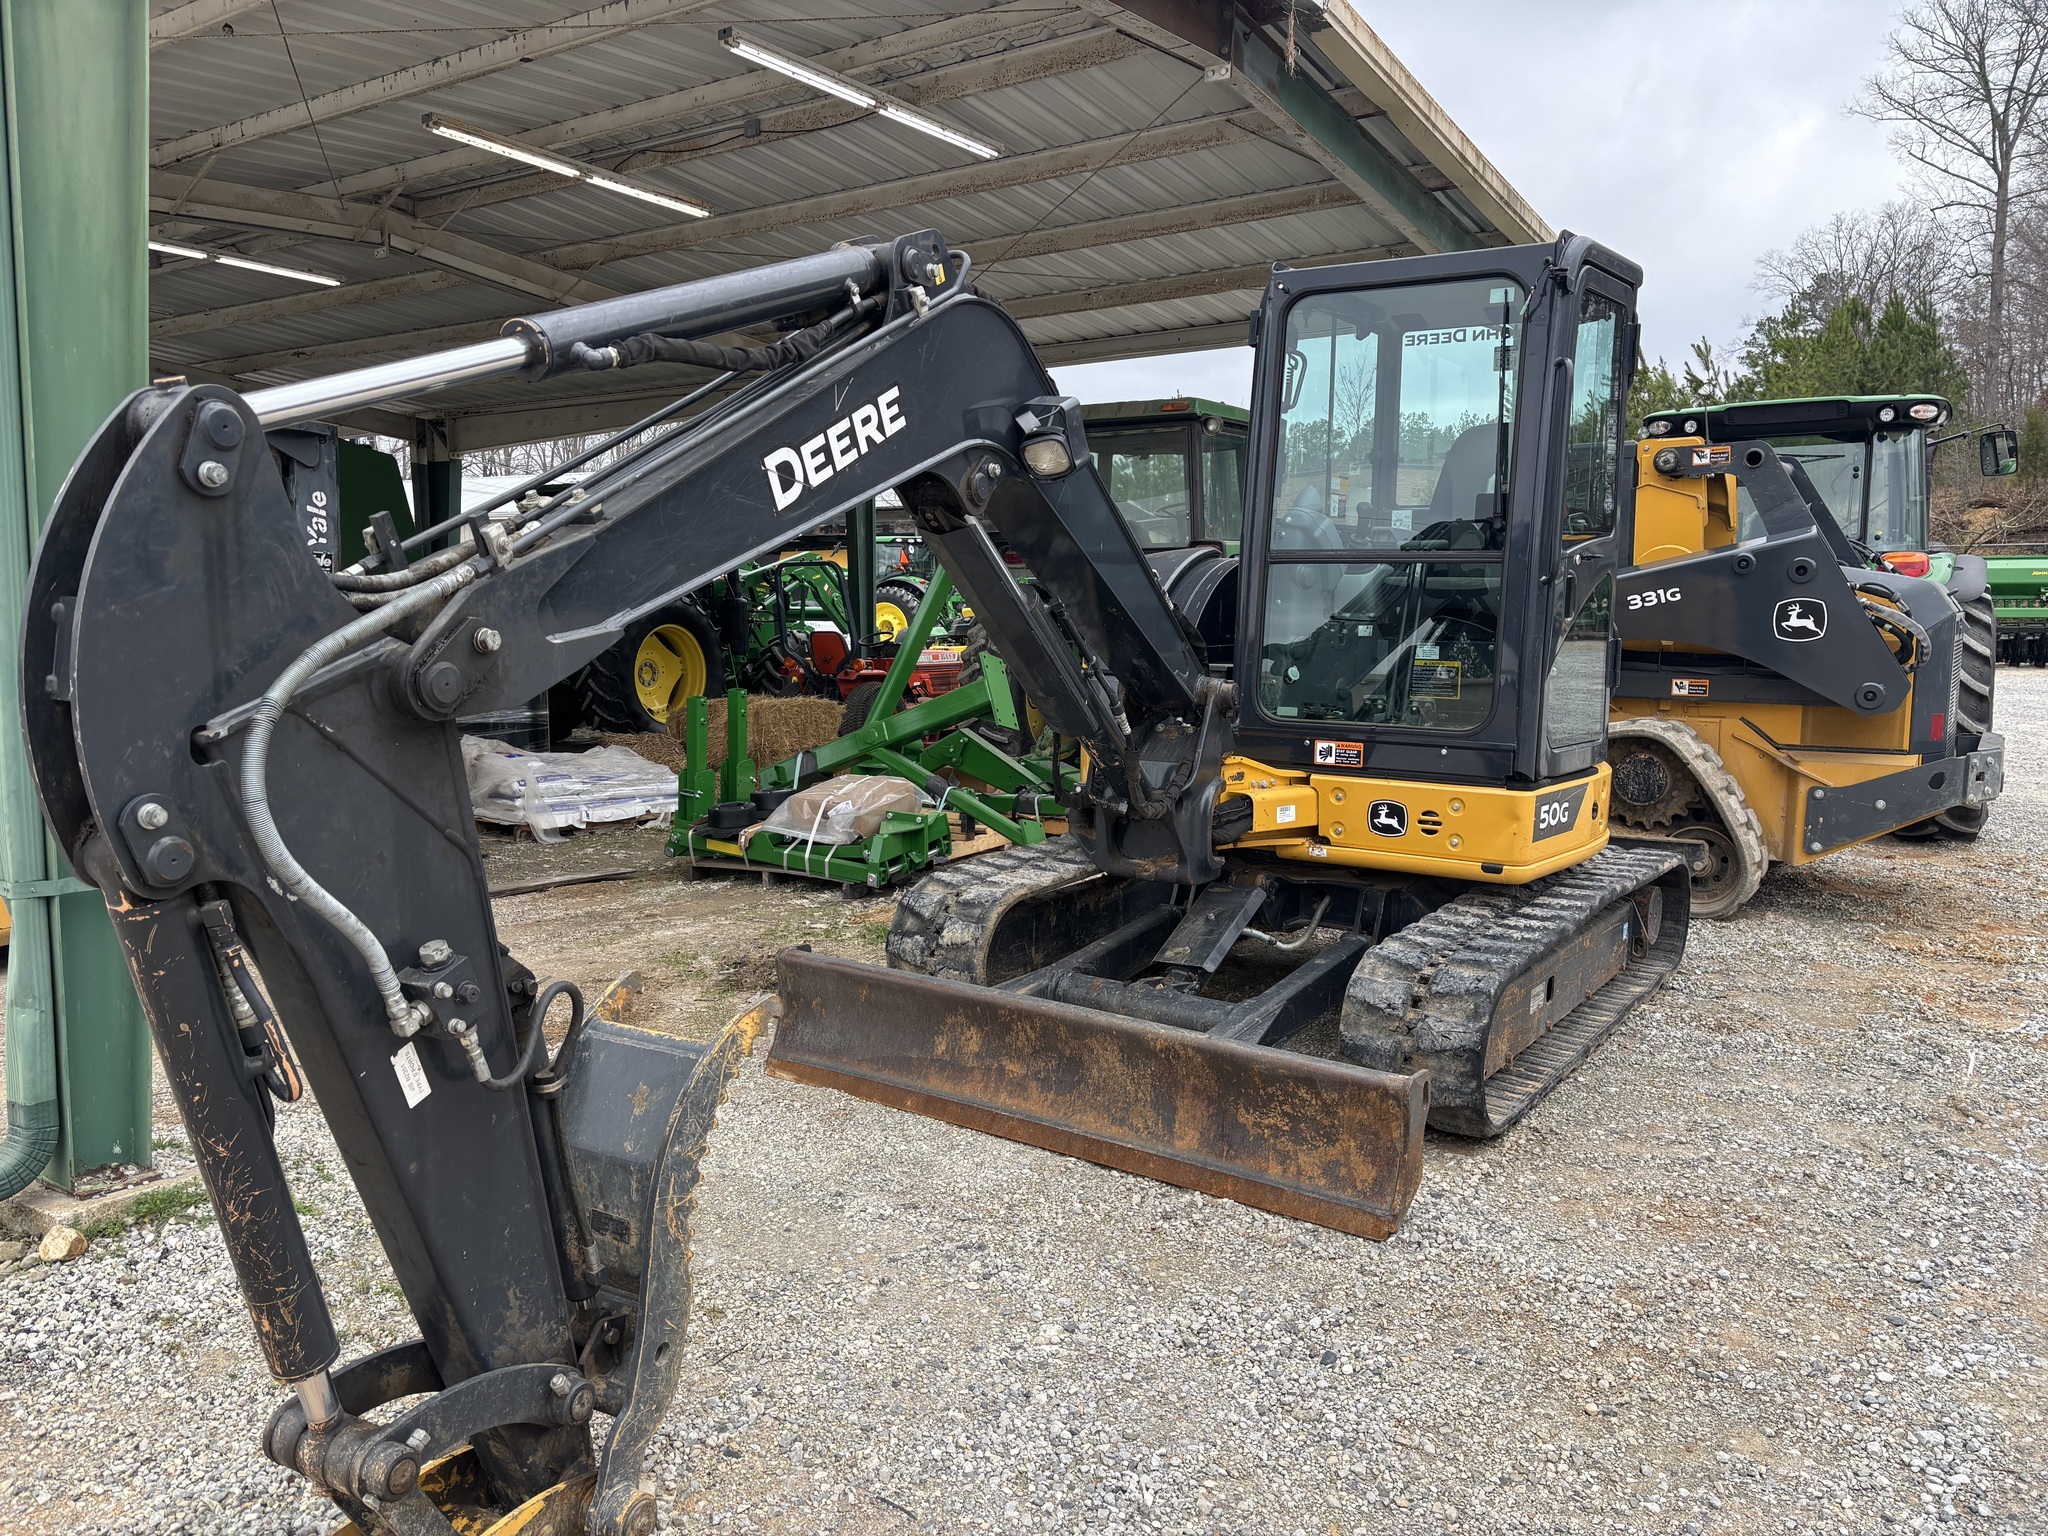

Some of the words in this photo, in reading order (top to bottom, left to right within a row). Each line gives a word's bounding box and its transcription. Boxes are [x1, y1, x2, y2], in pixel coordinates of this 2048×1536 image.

[764, 385, 907, 512] DEERE
[306, 490, 327, 547] Yale
[1626, 587, 1682, 610] 331G
[1539, 801, 1570, 830] 50G
